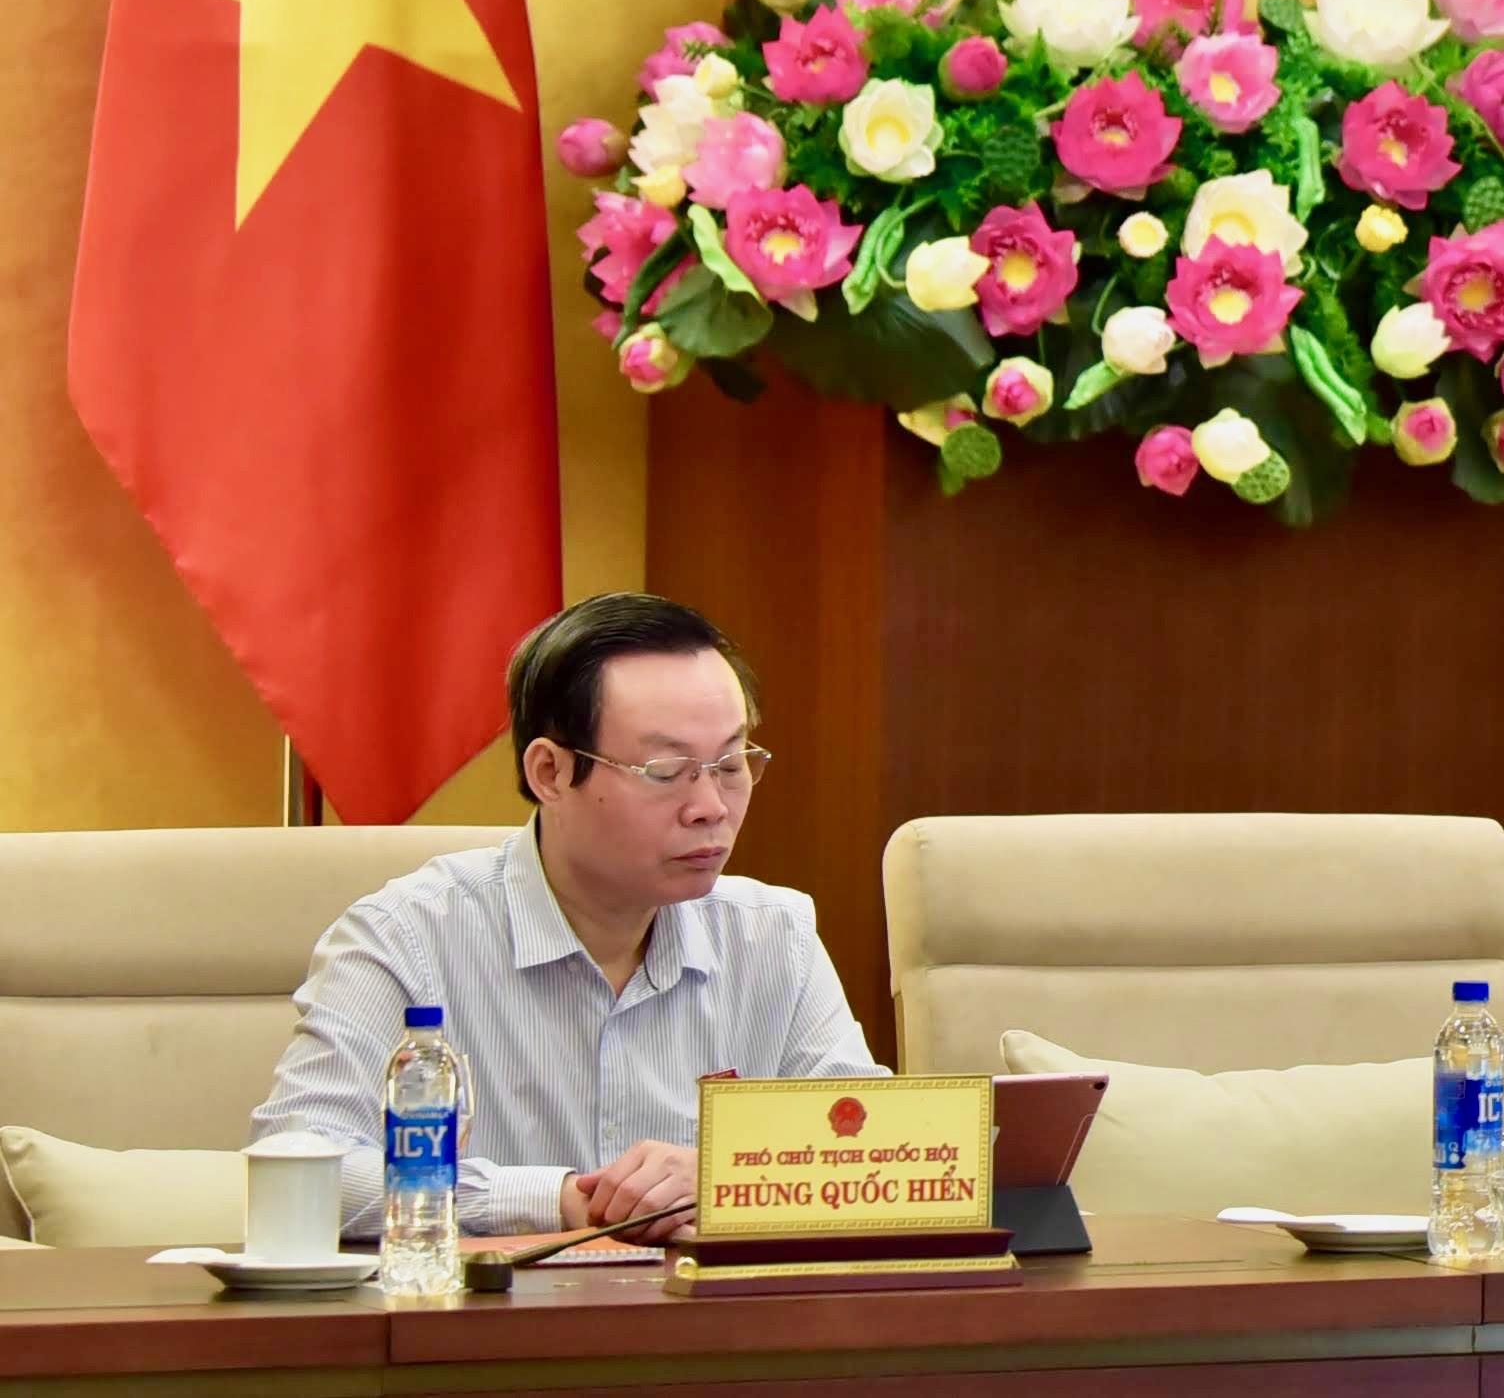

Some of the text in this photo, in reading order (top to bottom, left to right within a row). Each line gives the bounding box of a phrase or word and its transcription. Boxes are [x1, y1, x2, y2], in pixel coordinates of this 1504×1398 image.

[1478, 1092, 1504, 1123] IC
[393, 1126, 449, 1159] ICY
[732, 1142, 959, 1168] PHÓ CHỦ TỊCH QUỐC HỘI
[714, 1164, 976, 1210] PHÙNG QUỐC HIỂN
